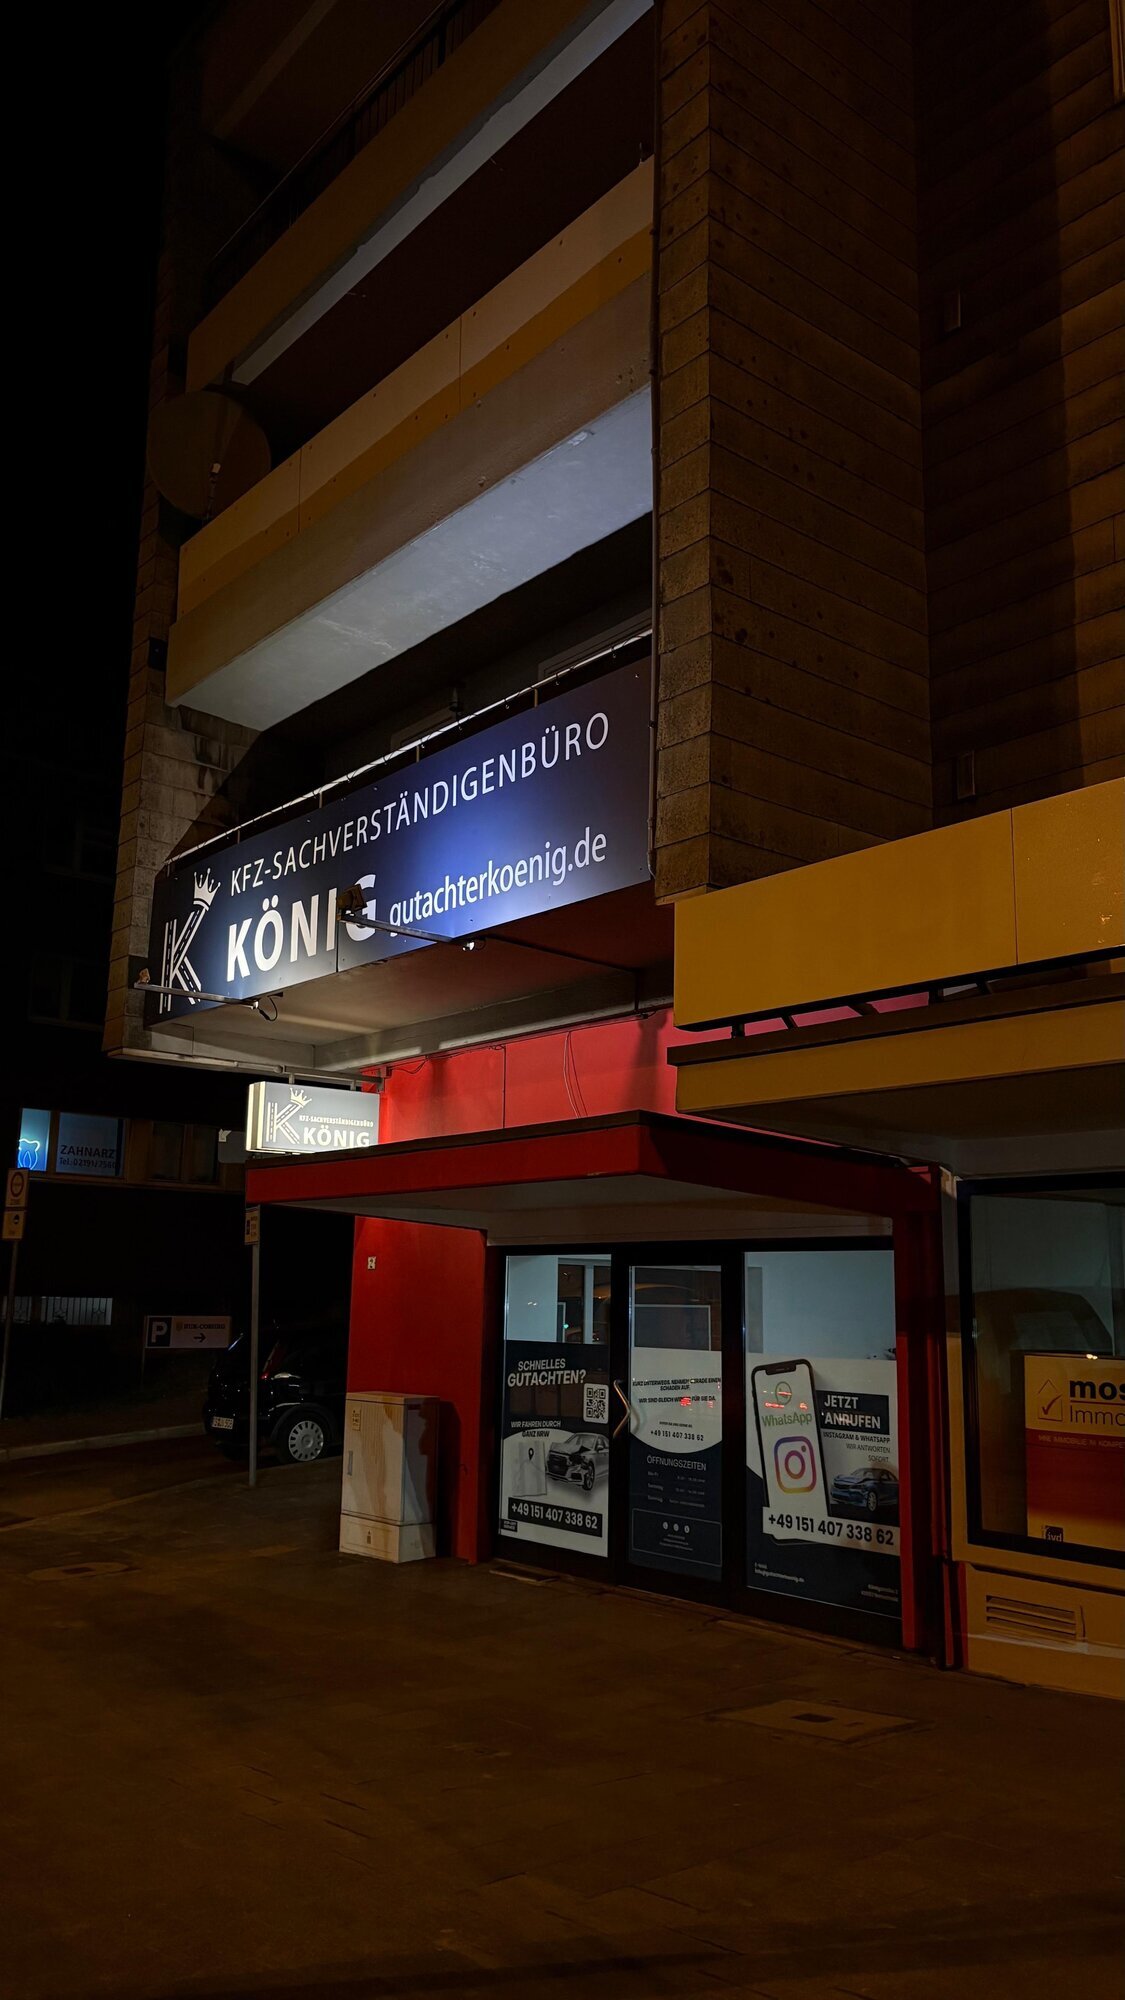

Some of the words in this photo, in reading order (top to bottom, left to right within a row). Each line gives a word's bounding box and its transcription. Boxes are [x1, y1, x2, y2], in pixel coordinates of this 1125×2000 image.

[231, 712, 609, 897] KFZ-SACHVERSTÄNDIGENBÜRO
[389, 826, 607, 937] gutachterkoenig.de
[303, 1124, 371, 1148] KÖNIG
[151, 1321, 168, 1344] P
[518, 1358, 566, 1371] SCHNELLES
[507, 1369, 587, 1388] GUTACHTEN?
[824, 1394, 859, 1410] JETZT
[522, 1420, 542, 1428] FAHREN
[543, 1420, 561, 1428] DURCH
[761, 1412, 813, 1427] WhatsApp
[824, 1411, 881, 1430] ANRUFEN
[684, 1432, 695, 1440] 338
[697, 1433, 704, 1441] 62
[823, 1431, 854, 1440] INSTAGRAM
[860, 1435, 891, 1444] WHATSAPP
[857, 1443, 891, 1454] ANTWORTEN
[646, 1454, 707, 1471] ÖFFNUNGSZEITEN
[511, 1502, 529, 1516] +49
[530, 1504, 544, 1519] 151
[545, 1507, 563, 1522] 407
[565, 1510, 583, 1527] 338
[585, 1515, 598, 1529] 62
[768, 1513, 793, 1529] +49
[795, 1516, 814, 1533] 151
[818, 1520, 843, 1537] 407
[846, 1524, 872, 1542] 338
[876, 1529, 894, 1546] 62
